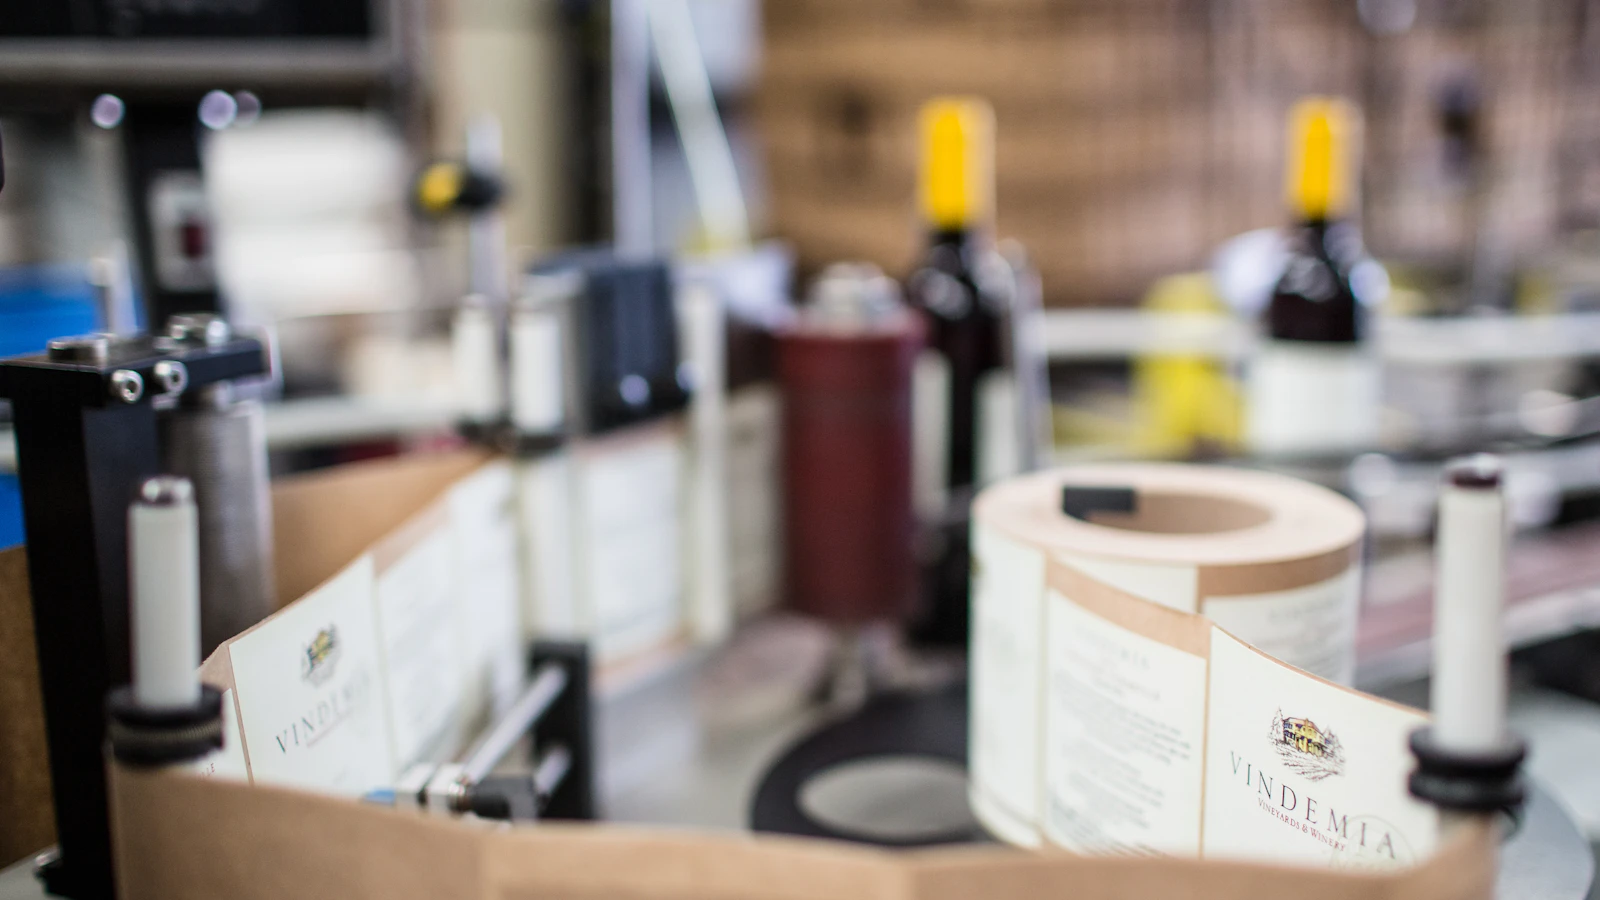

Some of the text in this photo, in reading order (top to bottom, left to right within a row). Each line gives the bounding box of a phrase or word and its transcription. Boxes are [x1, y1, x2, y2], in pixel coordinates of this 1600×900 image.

[275, 668, 370, 753] VIND
[1230, 751, 1396, 860] VINDEMIA
[1257, 797, 1346, 852] VINEYARDS & WINERY
